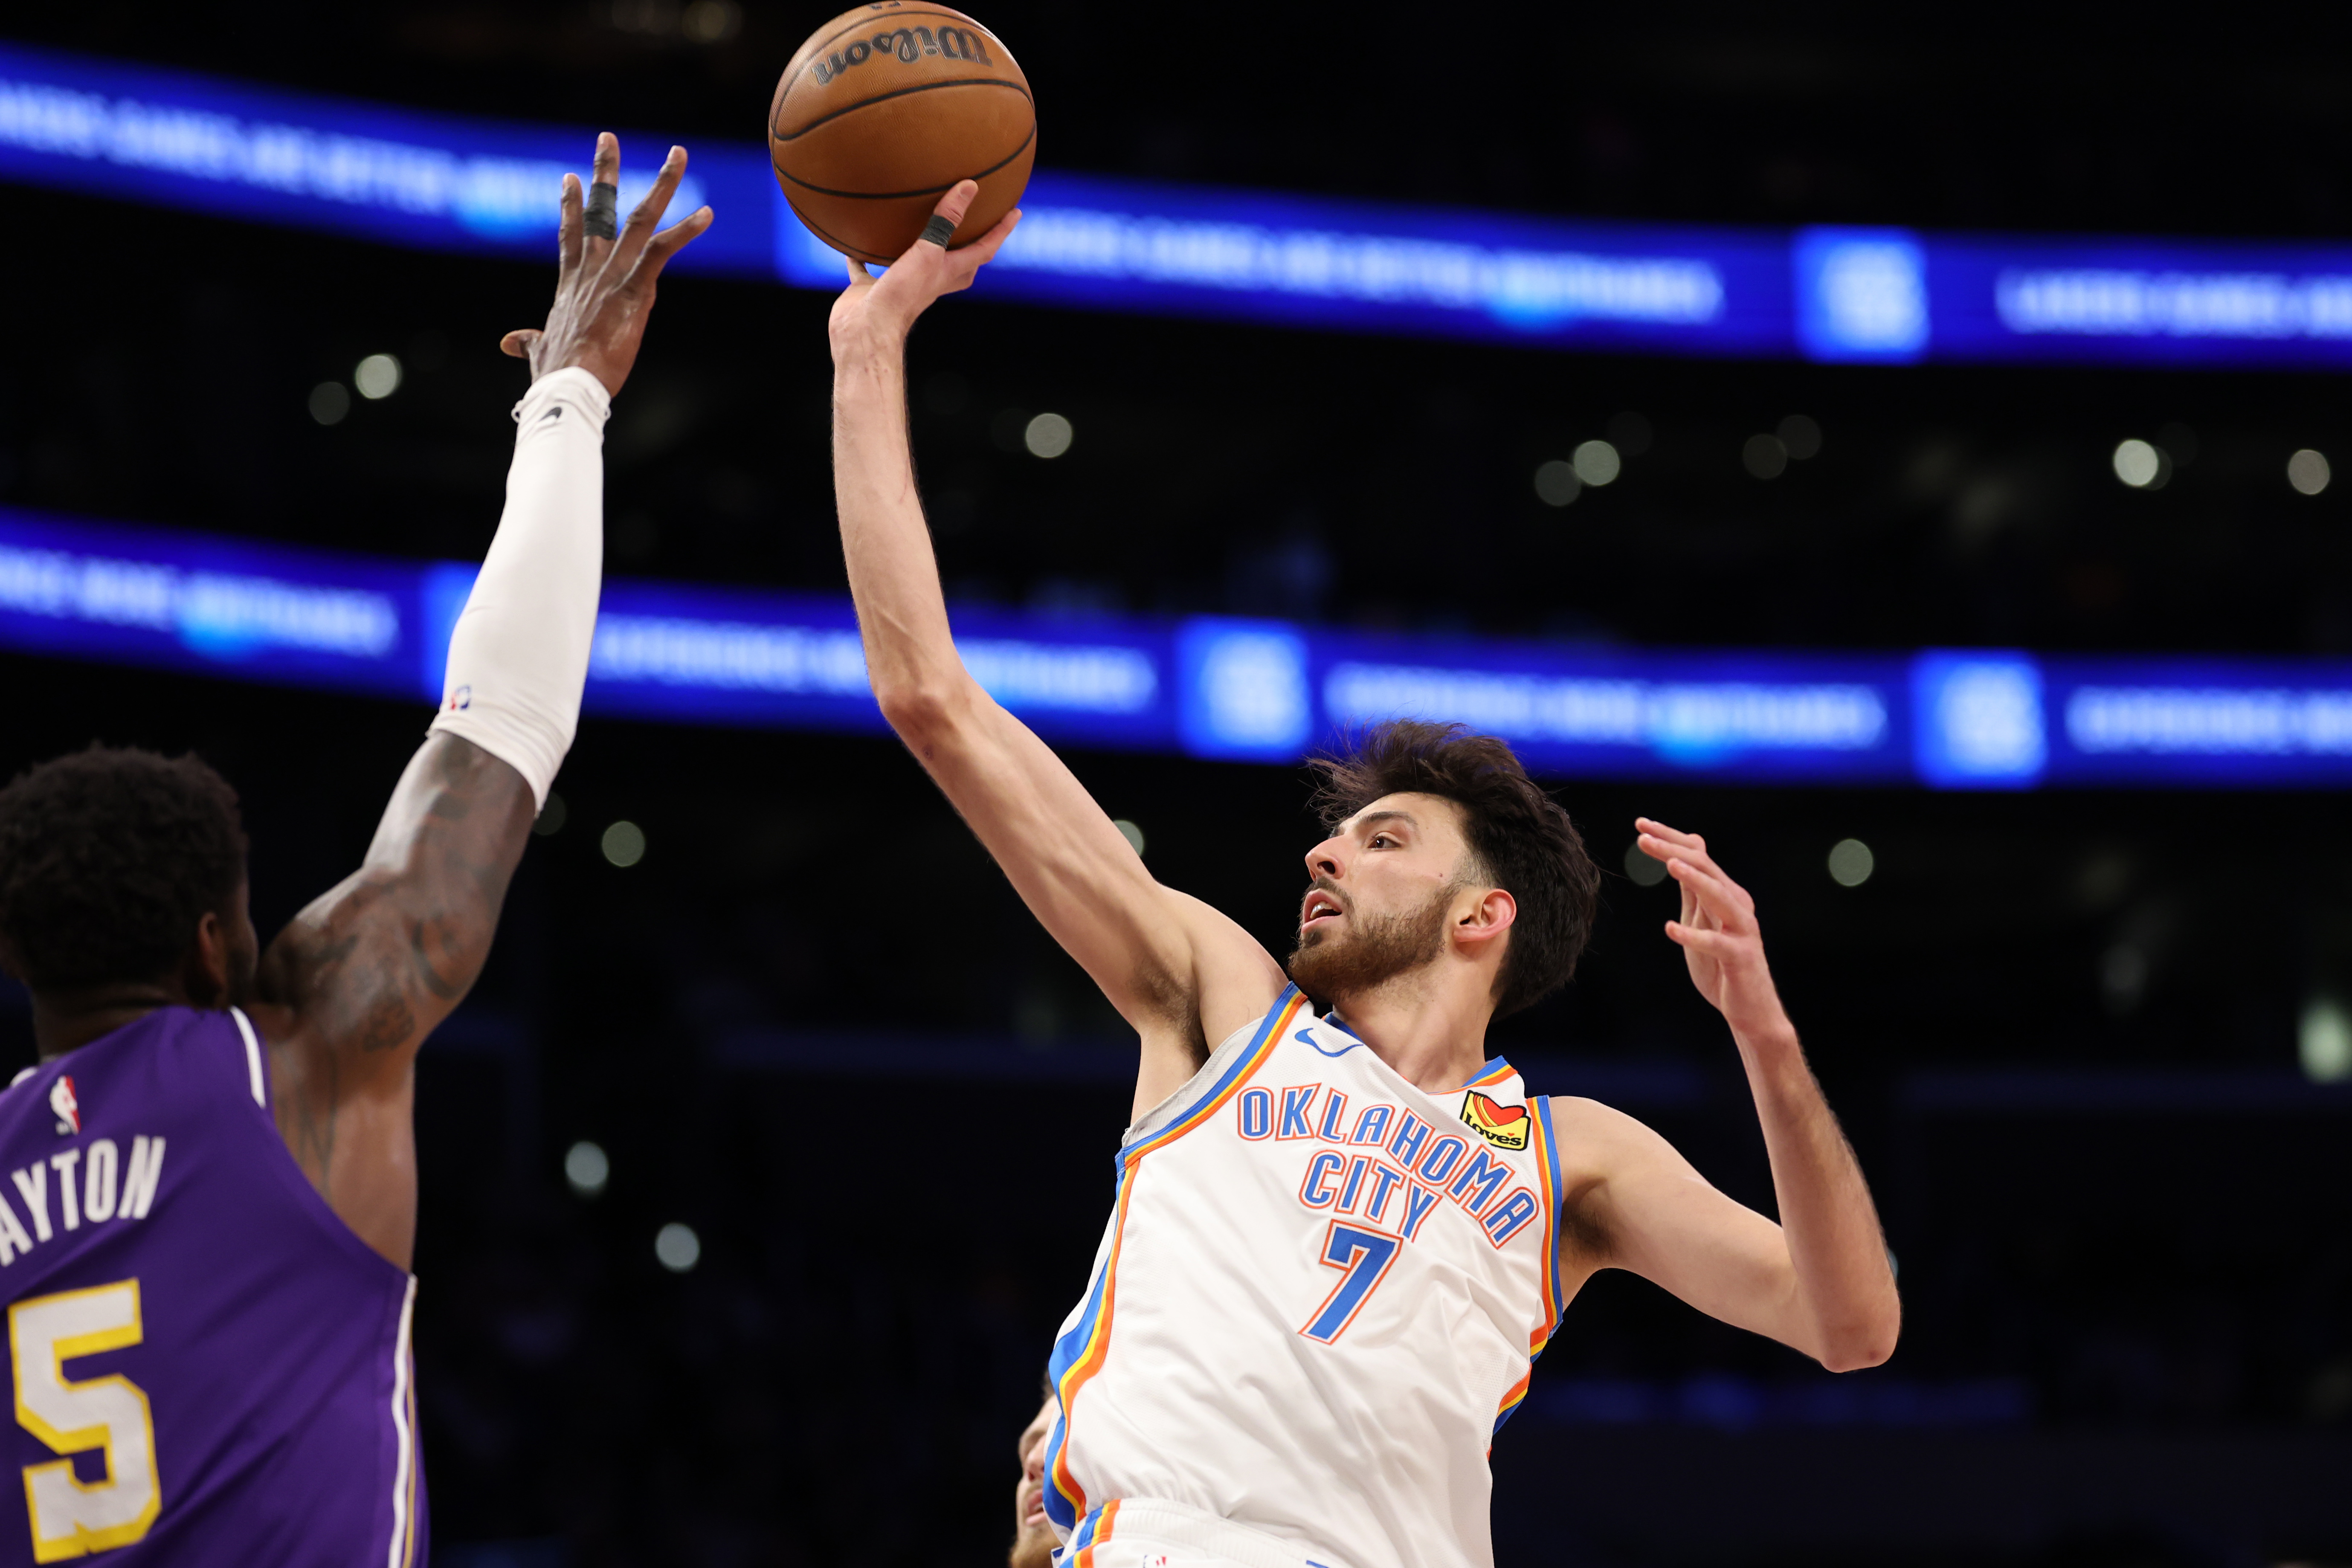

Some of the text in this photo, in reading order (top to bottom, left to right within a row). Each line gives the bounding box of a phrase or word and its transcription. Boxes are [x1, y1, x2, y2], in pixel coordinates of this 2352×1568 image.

[812, 26, 992, 86] Wilson
[0, 1135, 166, 1267] AYTON
[1238, 1083, 1539, 1249] OKLAHOMA
[1300, 1149, 1443, 1243] CITY
[1299, 1219, 1404, 1345] 7
[8, 1278, 162, 1564] 5
